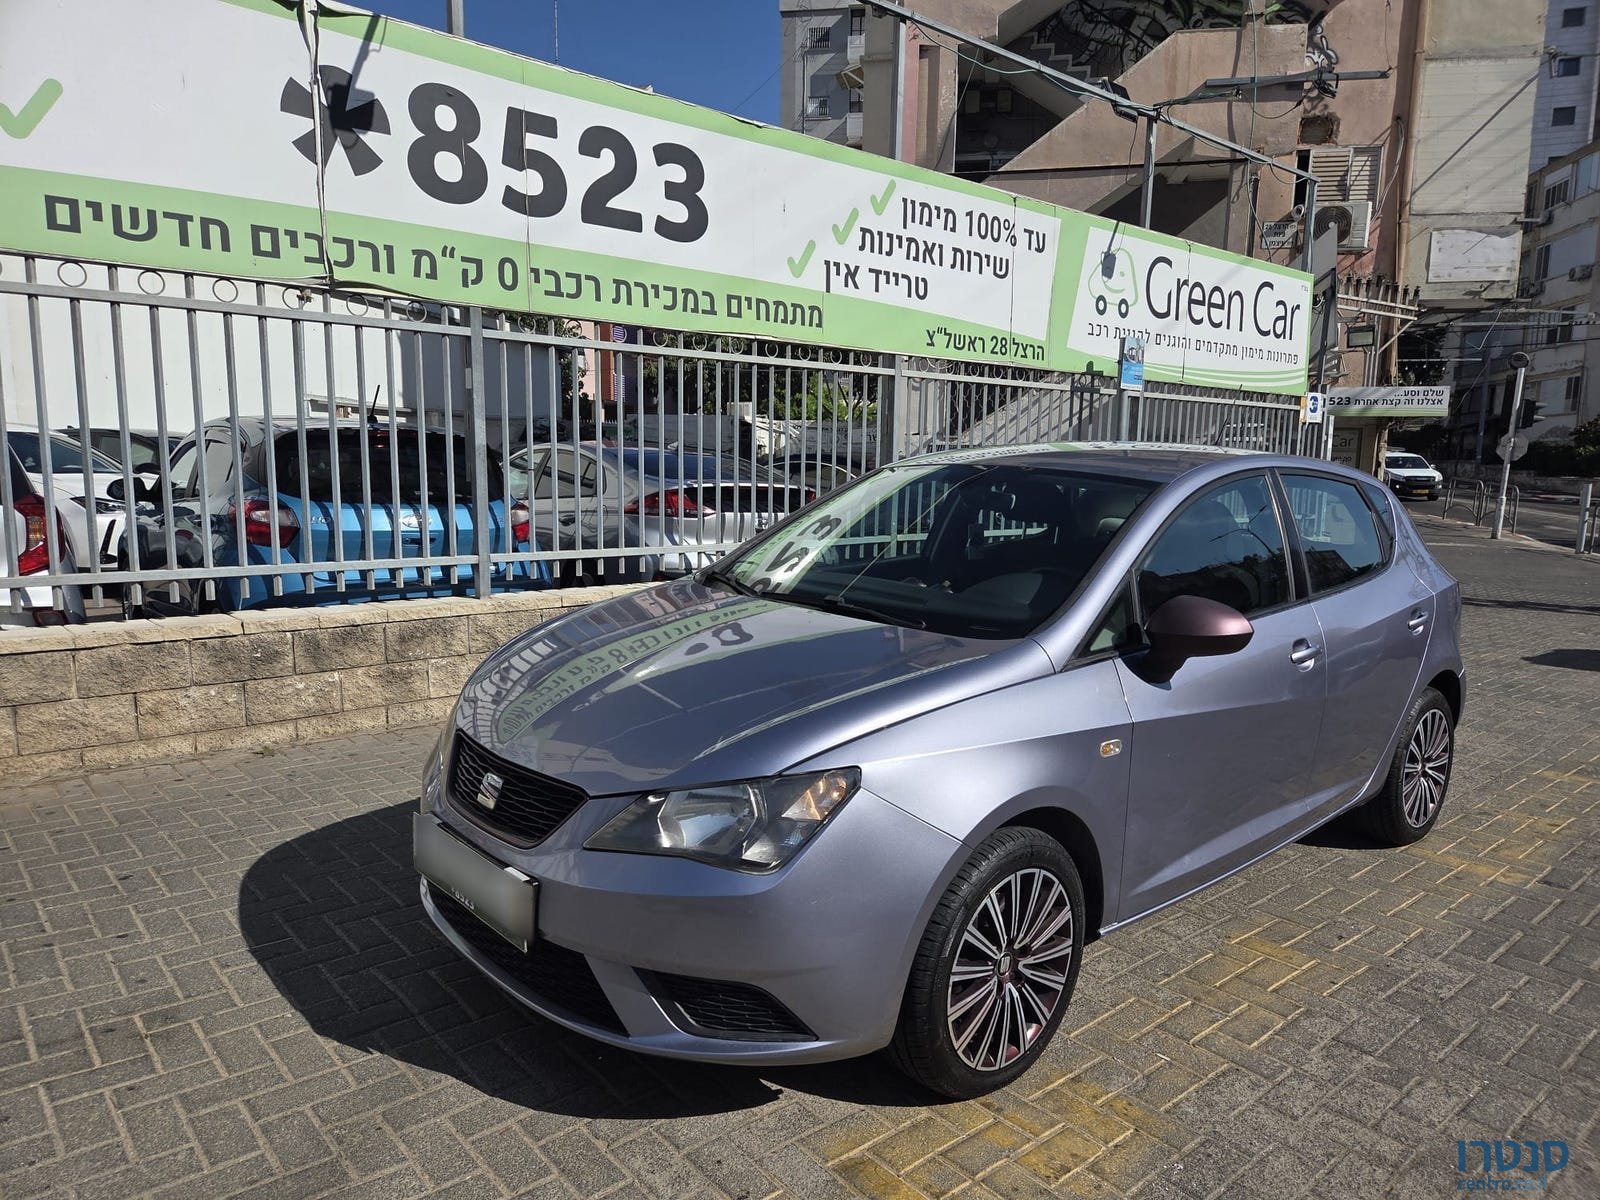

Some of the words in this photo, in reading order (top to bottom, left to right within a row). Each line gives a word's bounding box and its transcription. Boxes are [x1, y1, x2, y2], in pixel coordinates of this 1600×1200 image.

[44, 194, 231, 253] חדשים
[901, 197, 957, 233] מימון
[965, 209, 1017, 247] 100%
[250, 223, 395, 275] ורכבים
[858, 226, 945, 267] ואמינות
[1023, 227, 1047, 254] עד
[823, 259, 860, 293] אין
[950, 246, 1010, 280] שירות
[530, 266, 601, 302] רכבי
[612, 277, 718, 317] במכירת
[868, 267, 929, 301] טרייד
[725, 292, 823, 330] מתמחים
[1145, 255, 1244, 333] Green
[1253, 280, 1301, 342] Car
[1087, 322, 1109, 338] רכב
[1155, 333, 1191, 350] והוגנים
[989, 335, 1008, 356] 28
[1012, 336, 1045, 361] הרצל
[1195, 339, 1238, 358] מתקדמים
[1241, 345, 1264, 361] מימון
[1266, 350, 1299, 365] פתרונות
[1353, 398, 1379, 406] אחרת
[1381, 398, 1401, 407] קצת
[1403, 398, 1414, 406] זה
[1416, 397, 1443, 406] אצלנו
[1422, 388, 1444, 397] שלם
